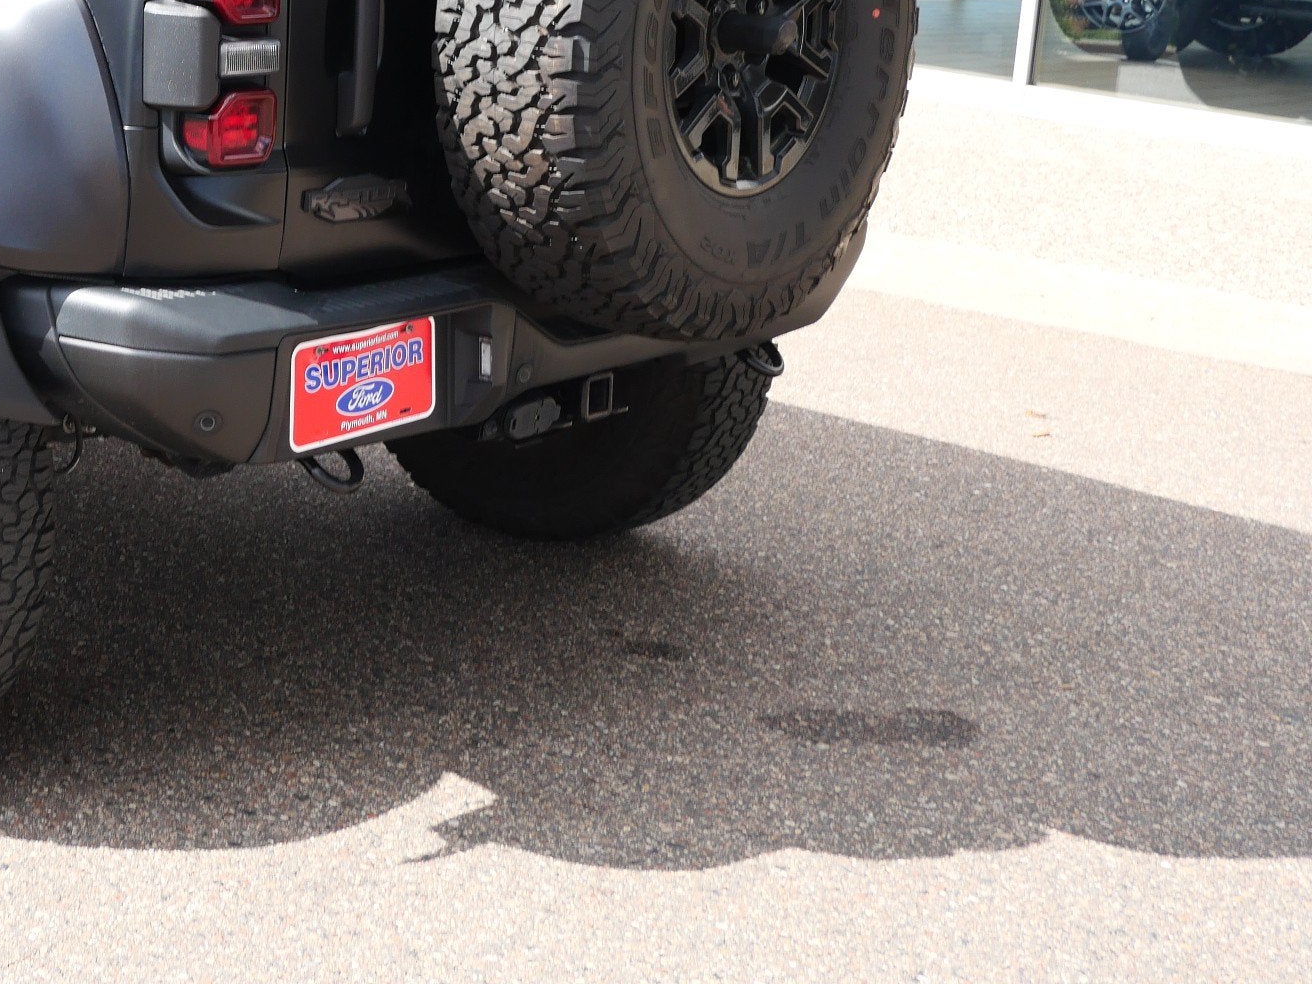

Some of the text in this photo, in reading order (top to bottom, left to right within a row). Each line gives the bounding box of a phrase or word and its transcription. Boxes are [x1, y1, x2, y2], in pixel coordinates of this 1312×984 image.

[332, 330, 399, 355] www.superiorford.com
[305, 337, 423, 393] SUPERIOR
[348, 382, 384, 412] Ford
[340, 414, 375, 432] Plymouth,
[375, 409, 387, 422] MN
